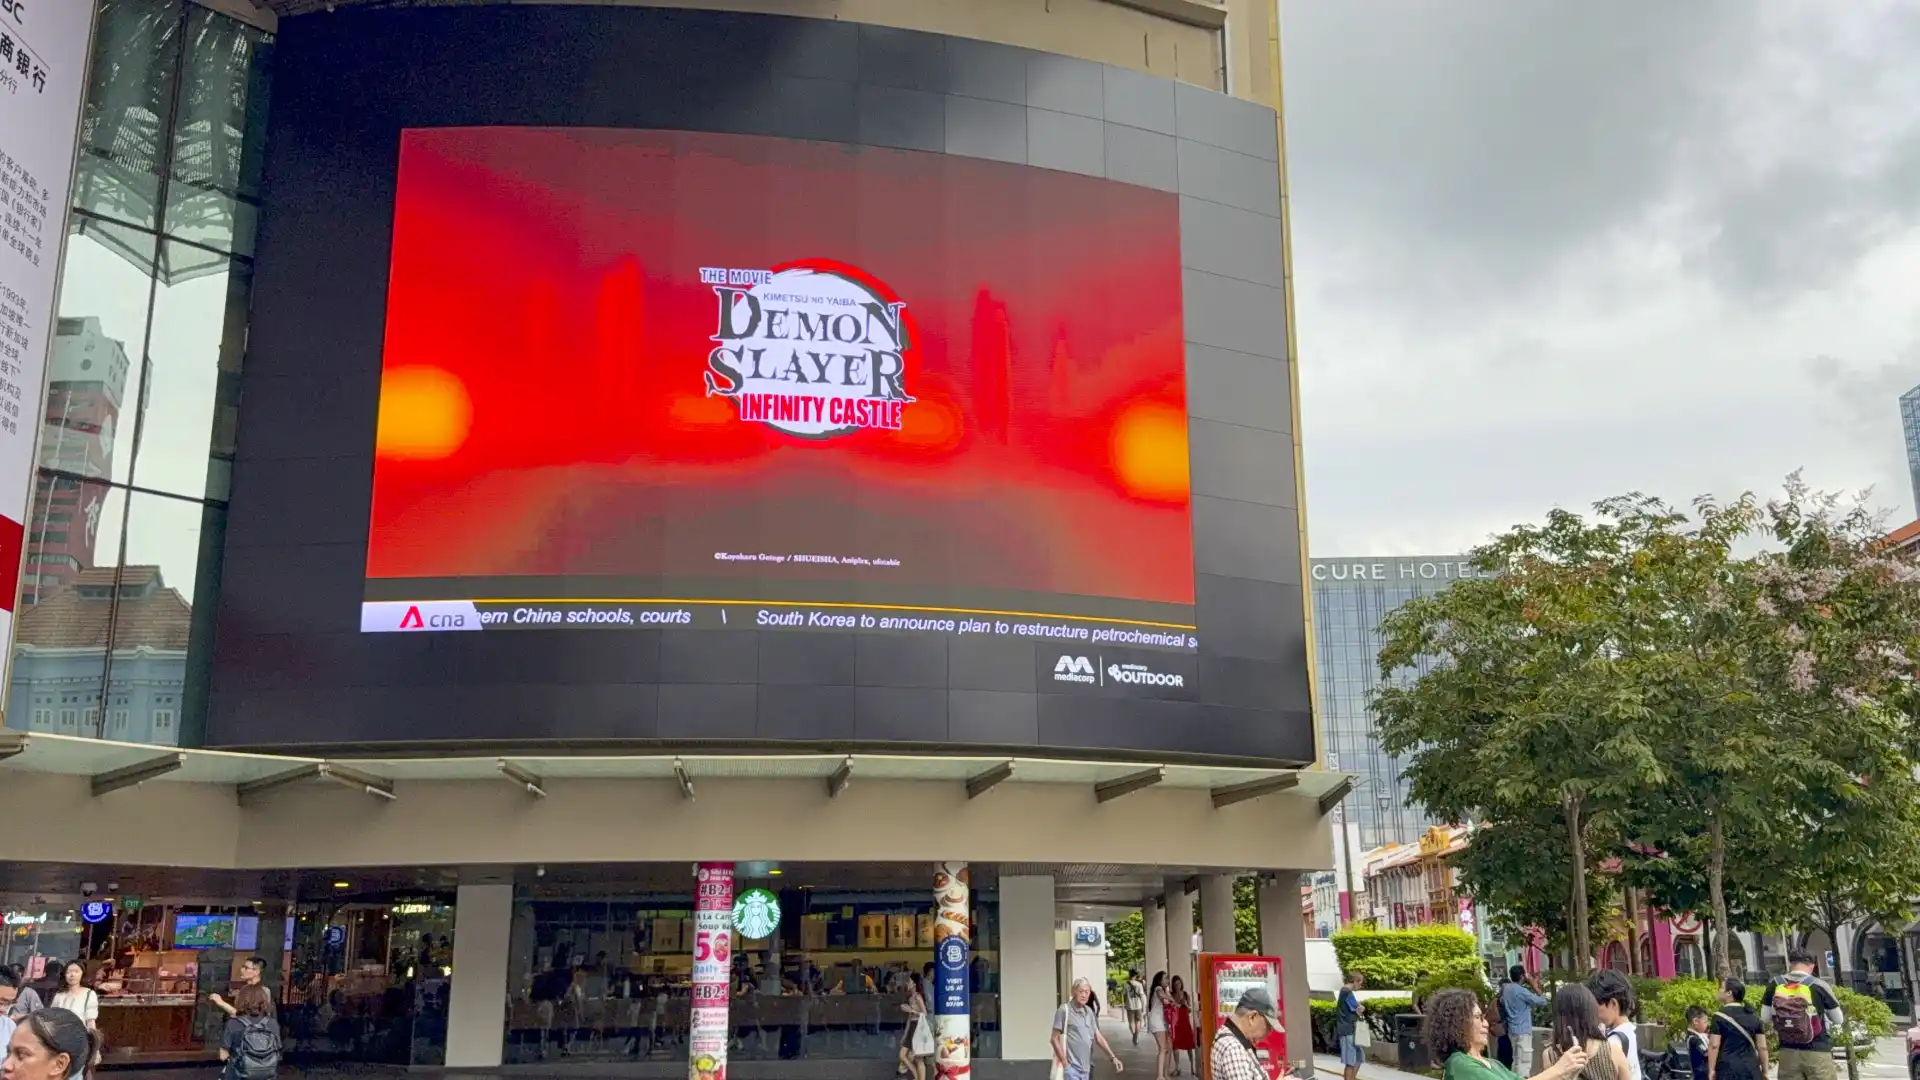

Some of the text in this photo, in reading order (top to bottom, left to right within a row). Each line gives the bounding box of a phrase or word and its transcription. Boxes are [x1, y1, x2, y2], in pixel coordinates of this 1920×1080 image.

[700, 268, 772, 284] THE MOVIE
[763, 292, 808, 303] KIMETSU
[826, 296, 857, 306] YAIBA
[710, 286, 906, 351] DEMON
[704, 344, 916, 402] SLAYER
[742, 393, 902, 428] INFINITY CASTLE
[1312, 562, 1489, 580] CURE HOTEL
[430, 614, 465, 628] cna
[513, 608, 562, 624] China
[566, 607, 634, 626] schools,
[640, 609, 691, 624] courts
[756, 610, 803, 626] South
[808, 612, 856, 628] Korea
[860, 613, 875, 628] to
[879, 617, 955, 632] announce
[958, 617, 990, 636] plan
[995, 619, 1009, 635] to
[1013, 622, 1089, 639] restructure
[1092, 628, 1185, 646] petrochemical
[1054, 673, 1095, 683] mediacorp
[1121, 671, 1183, 687] OUTDOOR
